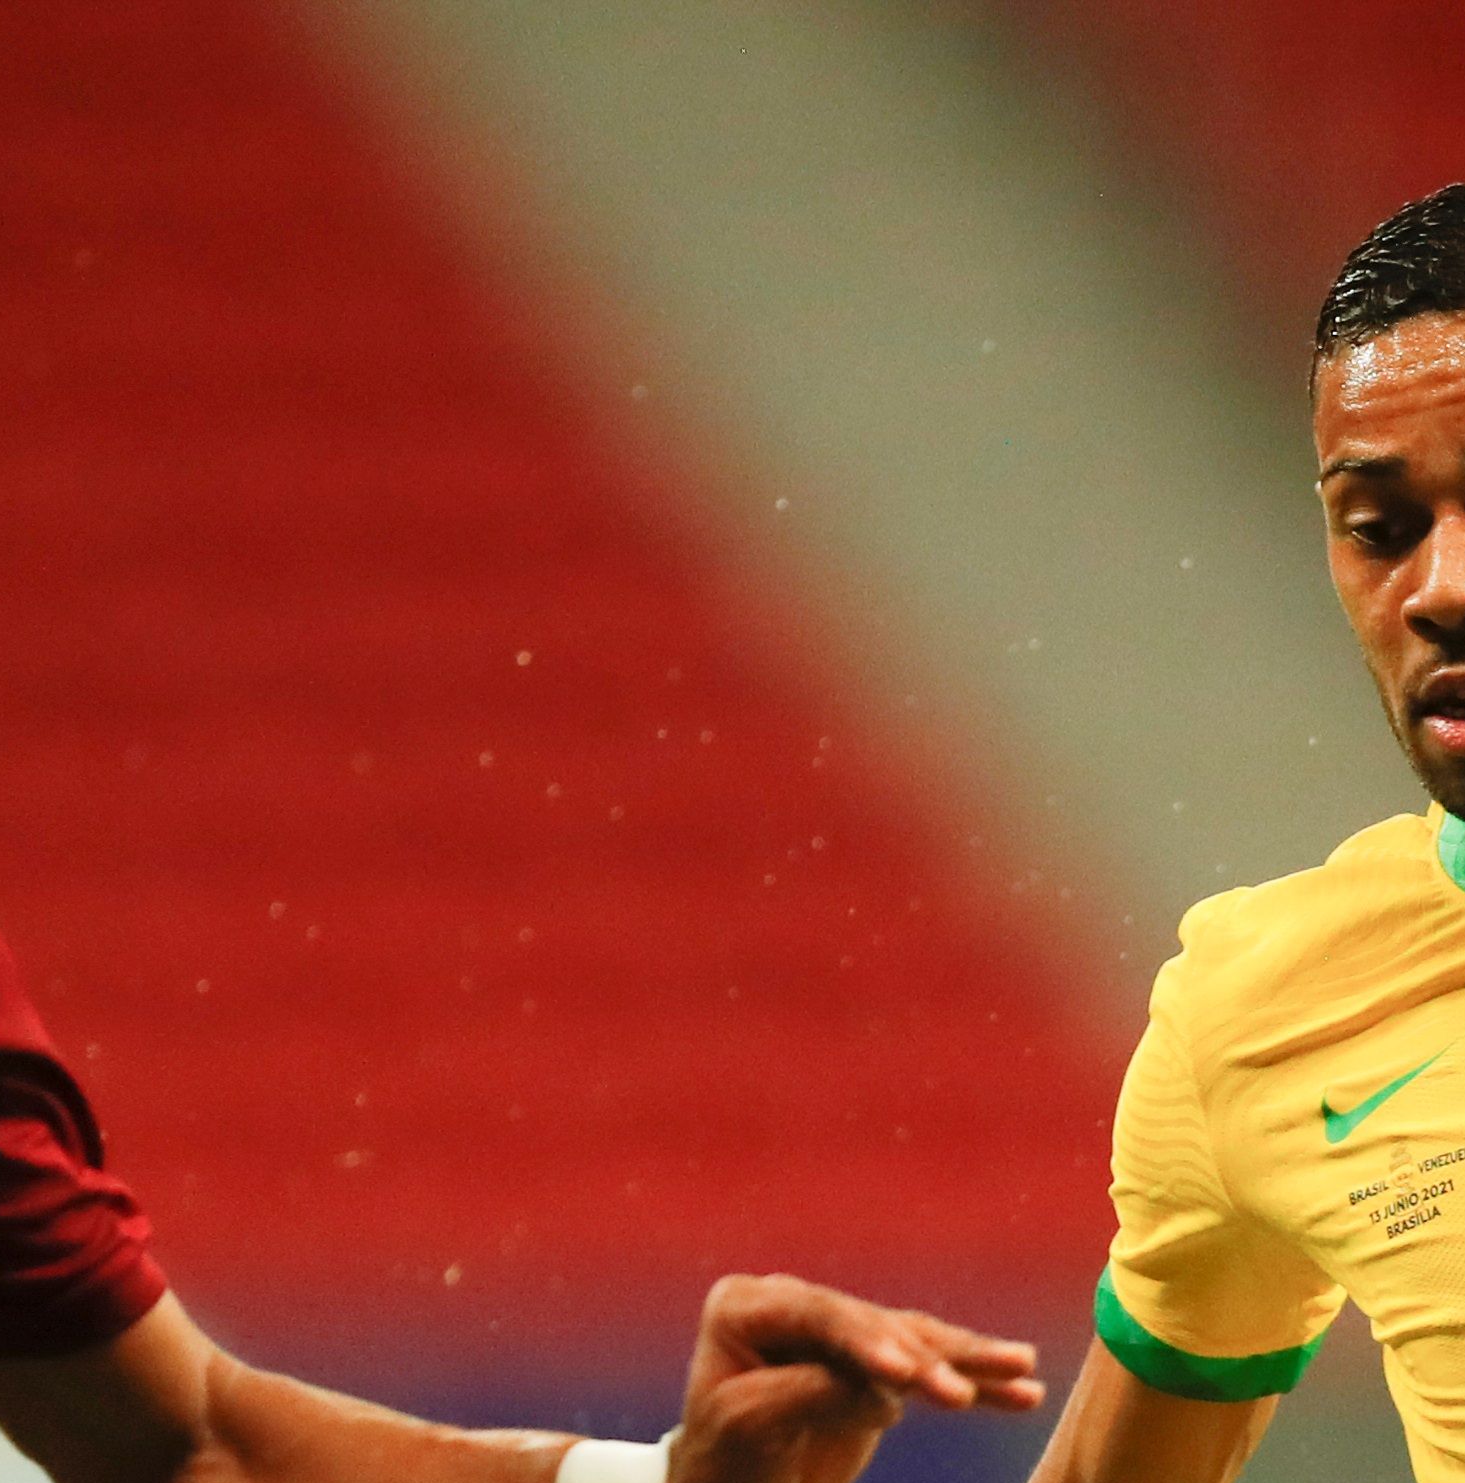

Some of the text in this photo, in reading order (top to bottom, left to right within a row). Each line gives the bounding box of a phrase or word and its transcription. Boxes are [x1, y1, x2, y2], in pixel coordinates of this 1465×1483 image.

[1348, 1180, 1389, 1206] BRASIL
[1369, 1179, 1455, 1225] 13 JUNIO 2021
